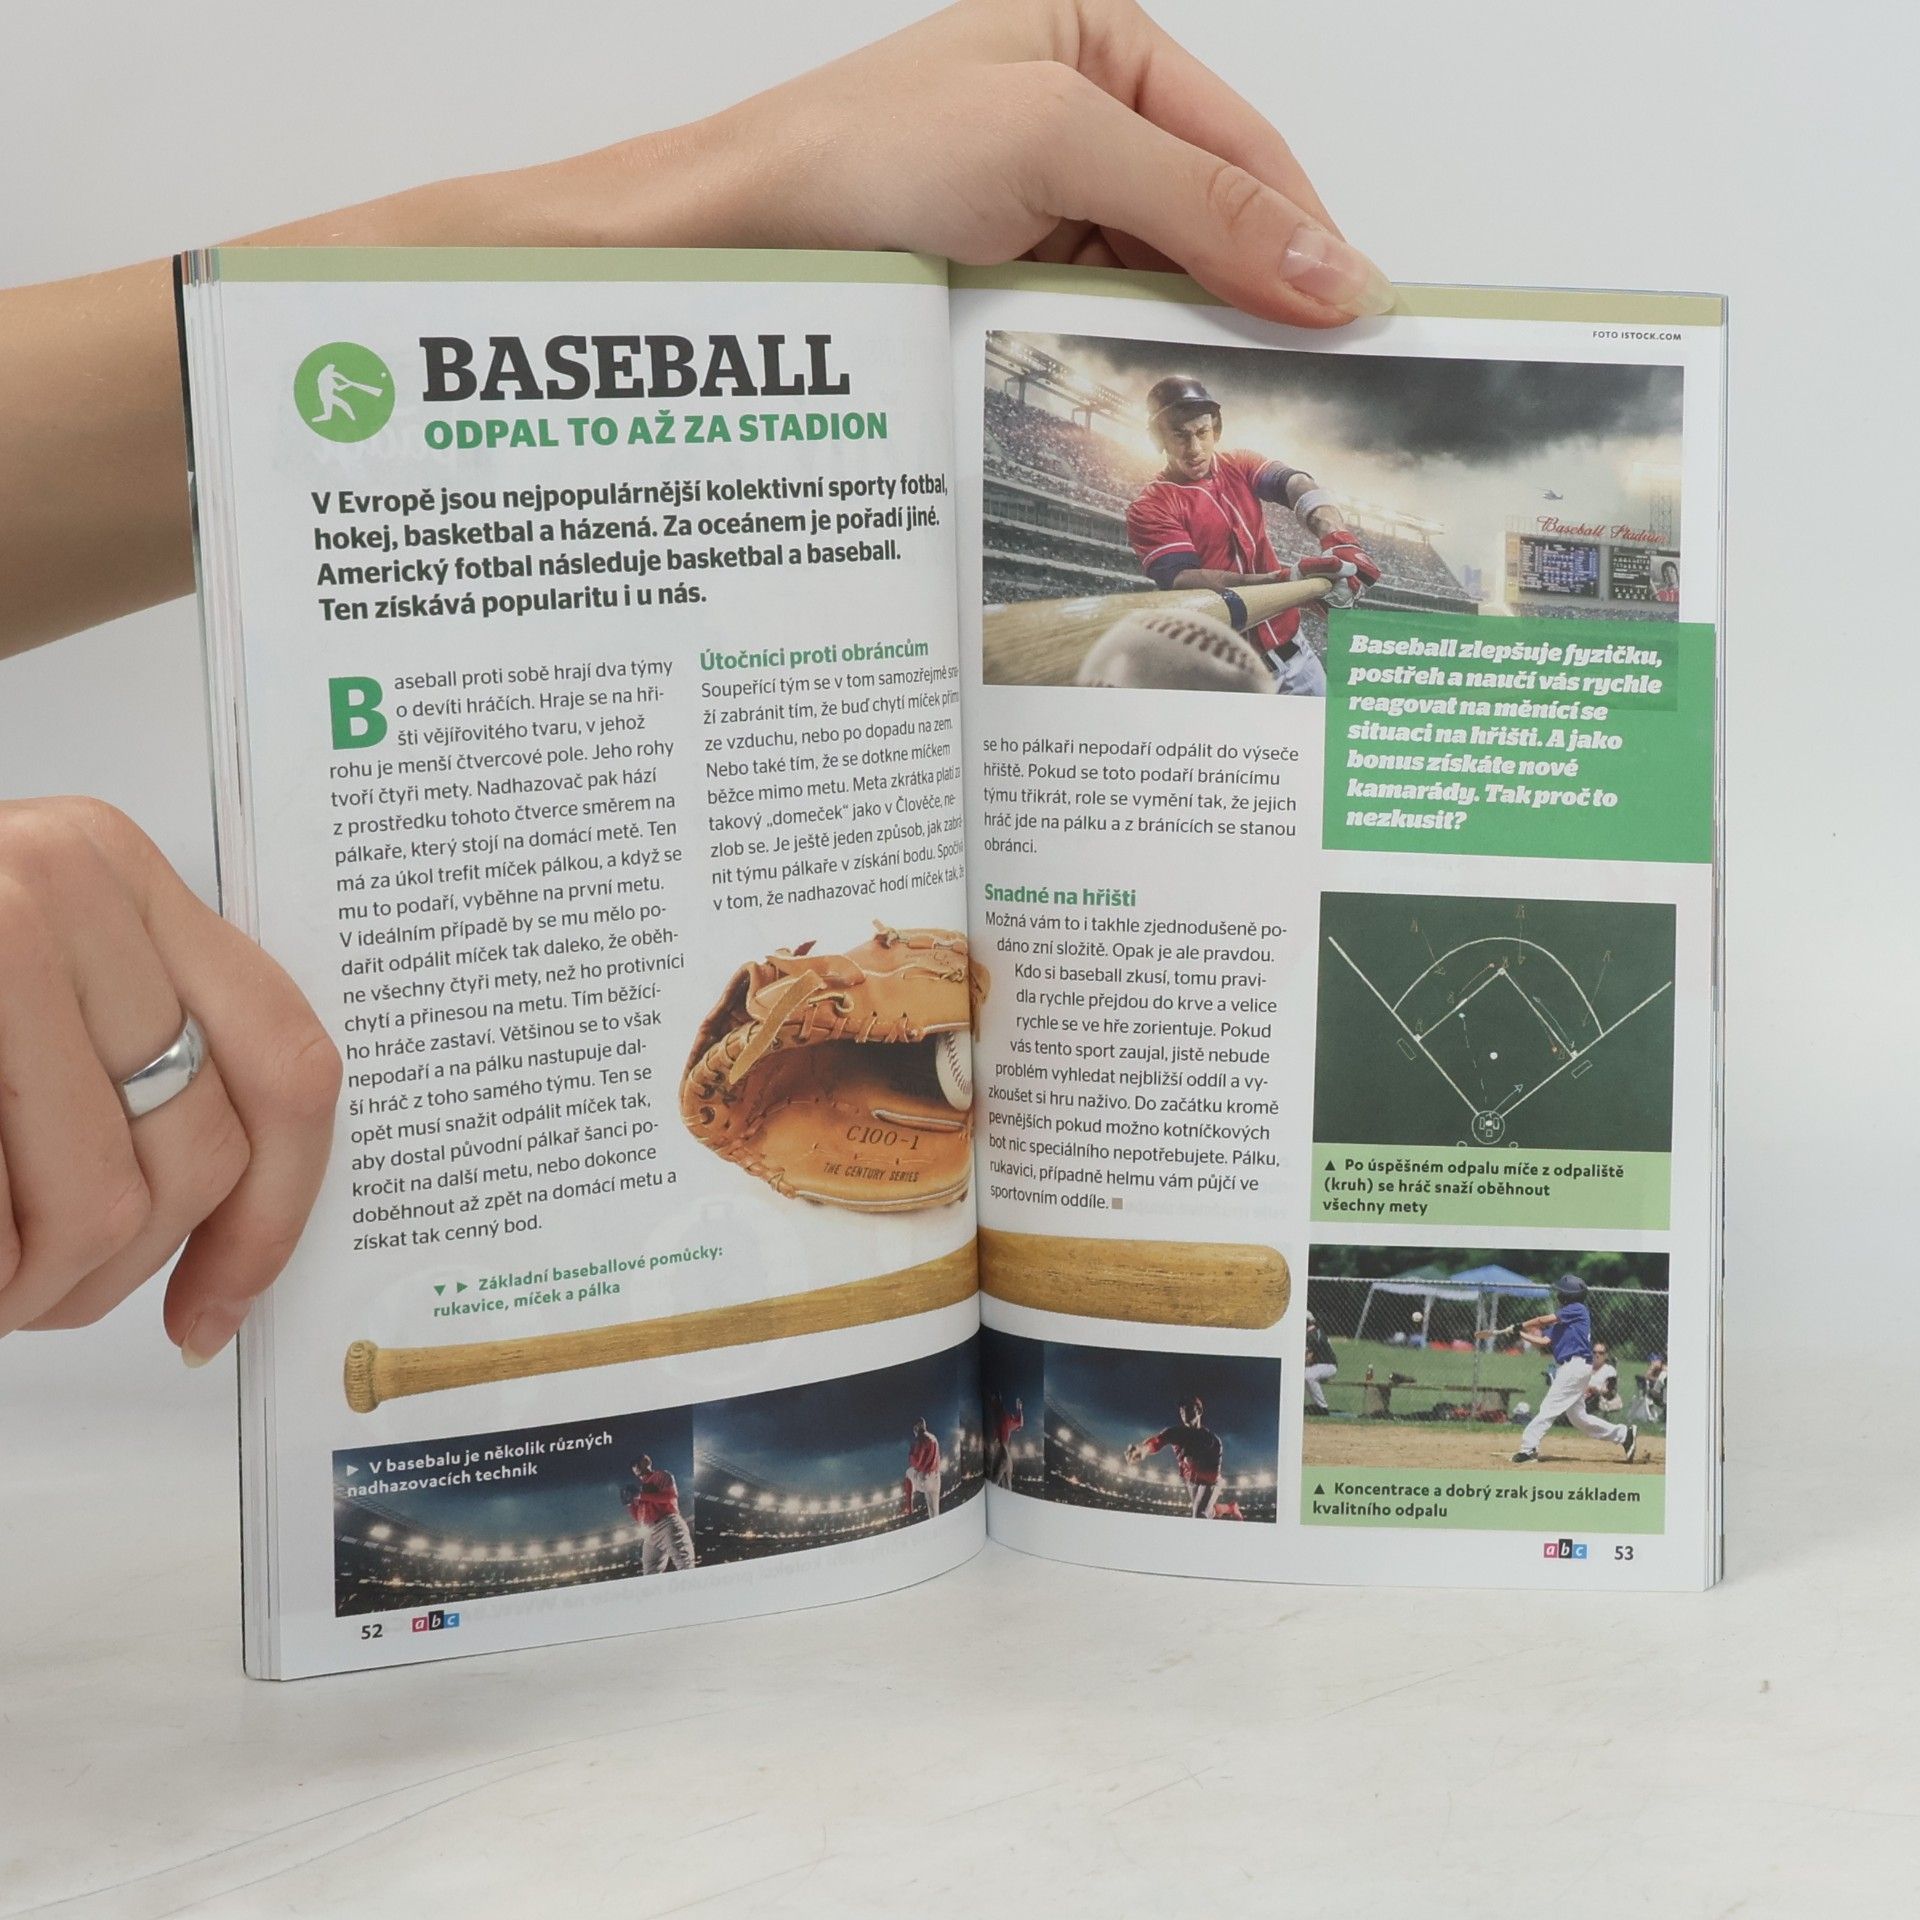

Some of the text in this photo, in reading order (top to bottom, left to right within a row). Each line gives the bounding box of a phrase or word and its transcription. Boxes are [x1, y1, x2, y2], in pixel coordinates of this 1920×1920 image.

[1593, 330, 1682, 341] FOTO ISTOCK.COM
[419, 334, 850, 403] BASEBALL
[424, 409, 887, 450] ODPAL TO AŽ ZA STADION
[311, 473, 948, 517] V Evropě jsou nejpopulárnější kolektivní sporty fotbal,
[314, 505, 940, 553] hokej, basketbal a házená. Za oceánem je pořadí jiné.
[317, 539, 901, 586] Americký fotbal následuje basketbal a baseball.
[318, 581, 707, 621] Ten získává popularitu i u nás.
[700, 638, 928, 671] Útočníci proti obráncům
[1349, 634, 1662, 668] Baseball zlepšuje fyzičku,
[1347, 665, 1662, 695] postřeh a naučí vás rychle
[1349, 695, 1608, 720] reagovat na měnící se
[983, 737, 1299, 762] se ho pálkaři nepodaří odpálit do výseče
[1348, 720, 1622, 752] situaci na hřišti. A jako
[706, 743, 950, 778] Nebo také tím, že se dotkne míčkem
[1347, 750, 1579, 777] bonus získáte nové
[330, 767, 656, 807] tvoří čtyři mety. Nadhazovač pak hází
[1347, 778, 1617, 808] kamarády. Tak proč to
[1346, 809, 1467, 829] nezkusit?
[985, 883, 1136, 907] Snadné na hřišti
[341, 928, 678, 976] dařit odpálit míček tak daleko, že oběh-
[1015, 963, 1267, 989] Kdo si baseball zkusí, tomu pravi-
[352, 1121, 659, 1171] aby dostal původní pálkař šanci po-
[846, 1125, 919, 1150] C100-1
[824, 1163, 920, 1182] THE CENTURY SERIES
[1345, 1158, 1624, 1180] Po úspěšném odpalu míče z odpaliště
[1324, 1176, 1550, 1196] (kruh) se hráč snaží oběhnout
[1322, 1197, 1428, 1216] všechny mety
[479, 1245, 723, 1291] Základní baseballové pomůcky:
[434, 1281, 620, 1317] rukavice, míček a pálka
[369, 1431, 612, 1474] V basebalu je několik různých
[347, 1461, 537, 1497] nadhazovacích technik
[1334, 1482, 1640, 1503] Koncentrace a dobrý zrak jsou základem
[1313, 1500, 1447, 1520] kvalitního odpalu
[1545, 1541, 1586, 1558] abc
[1614, 1545, 1634, 1560] 53
[361, 1624, 383, 1640] 52
[413, 1611, 458, 1632] abc
